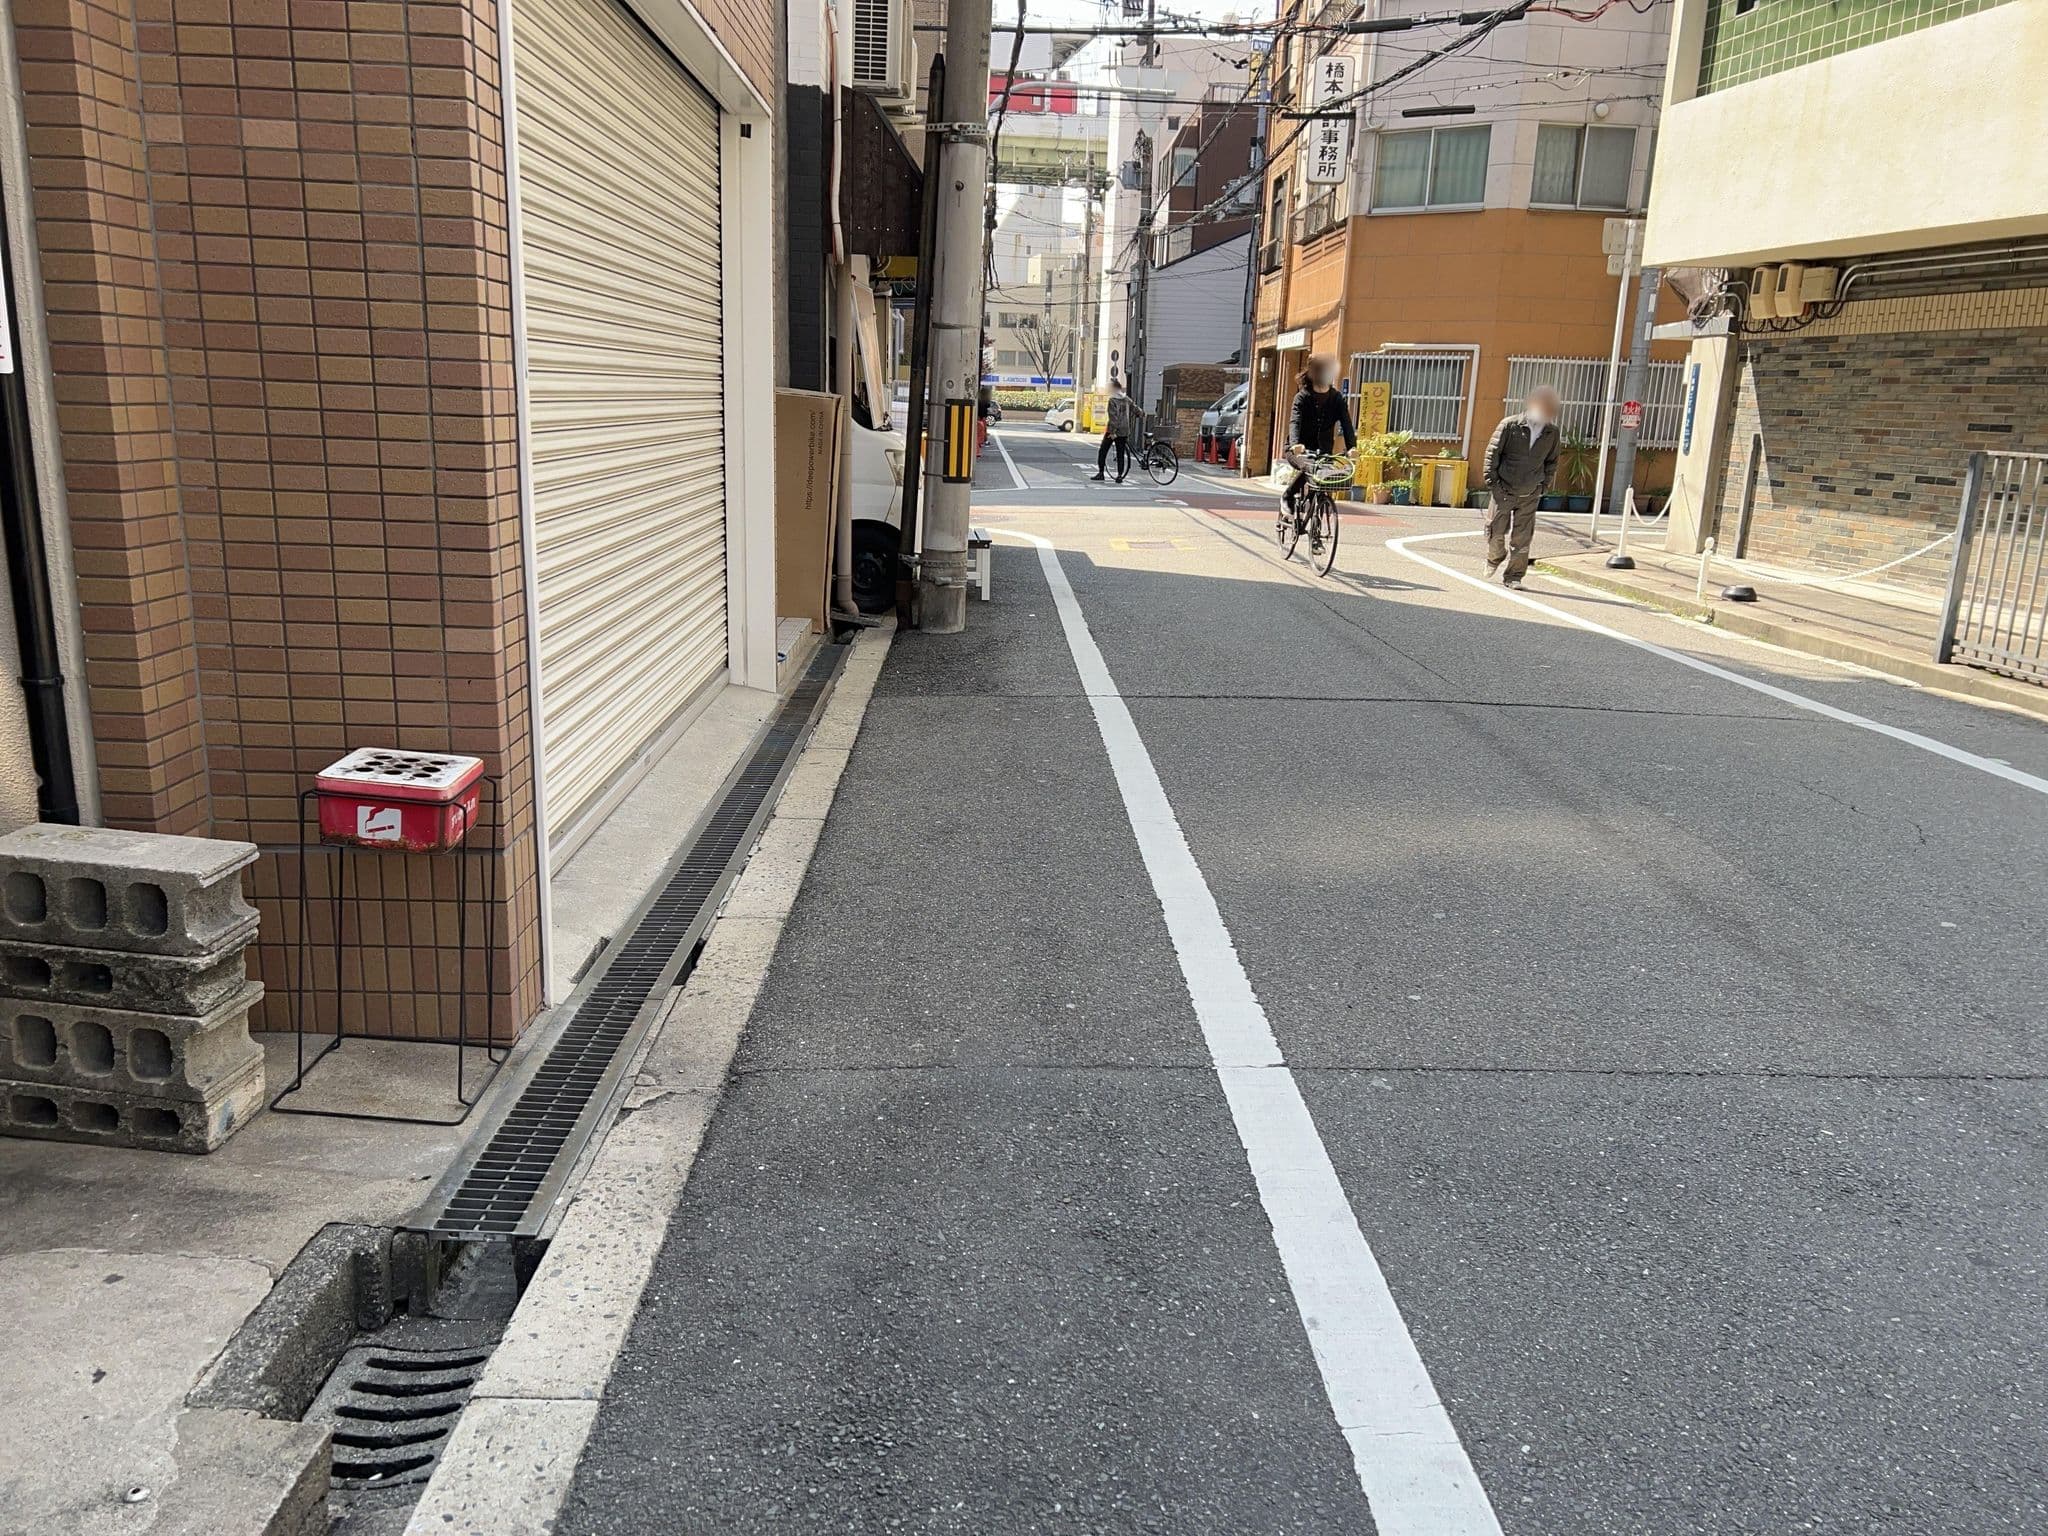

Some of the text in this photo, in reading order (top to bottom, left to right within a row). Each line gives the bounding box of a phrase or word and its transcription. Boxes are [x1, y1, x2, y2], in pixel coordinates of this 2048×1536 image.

[1317, 62, 1345, 178] 橋本計事務所
